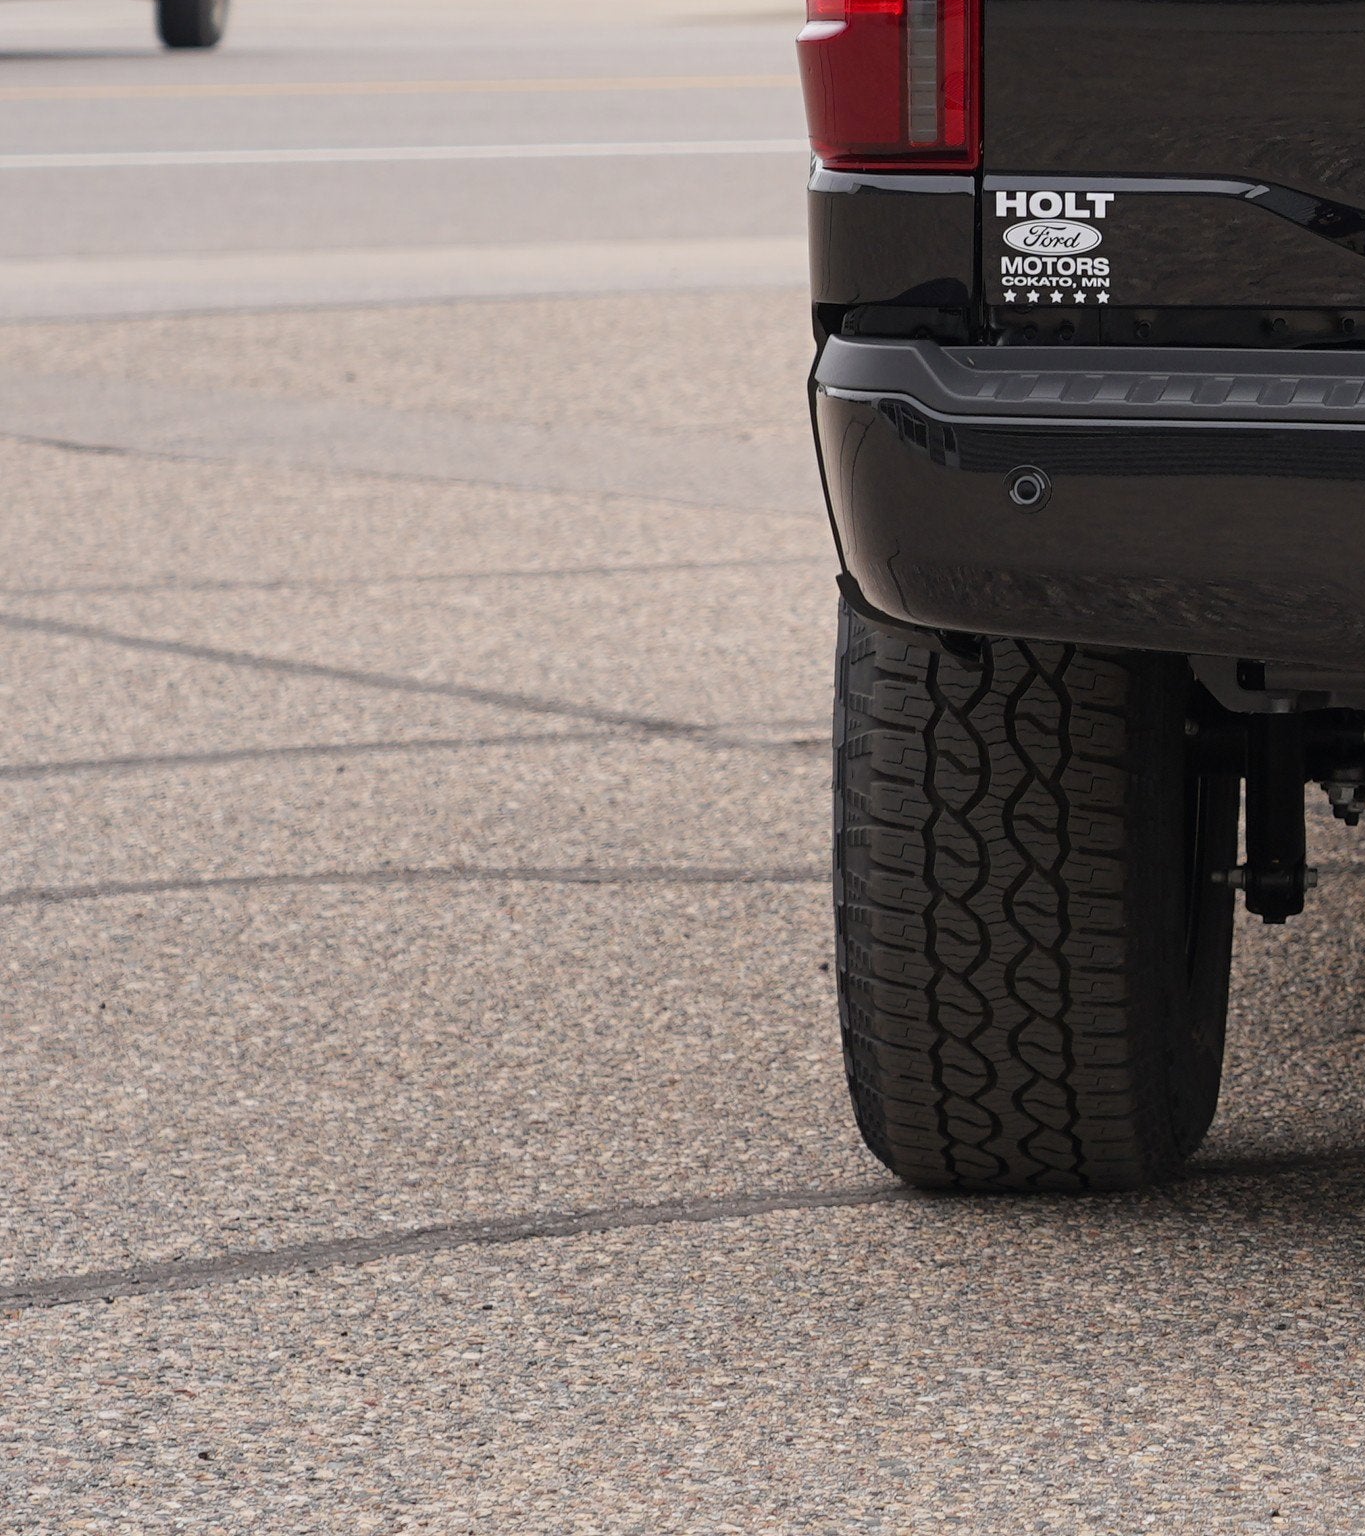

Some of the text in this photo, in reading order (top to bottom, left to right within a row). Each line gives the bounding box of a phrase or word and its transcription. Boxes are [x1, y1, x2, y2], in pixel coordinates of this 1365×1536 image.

[995, 191, 1115, 218] HOLT
[1023, 225, 1082, 249] Ford
[1000, 256, 1110, 276] MOTORS
[1001, 276, 1110, 289] COKATO, MN
